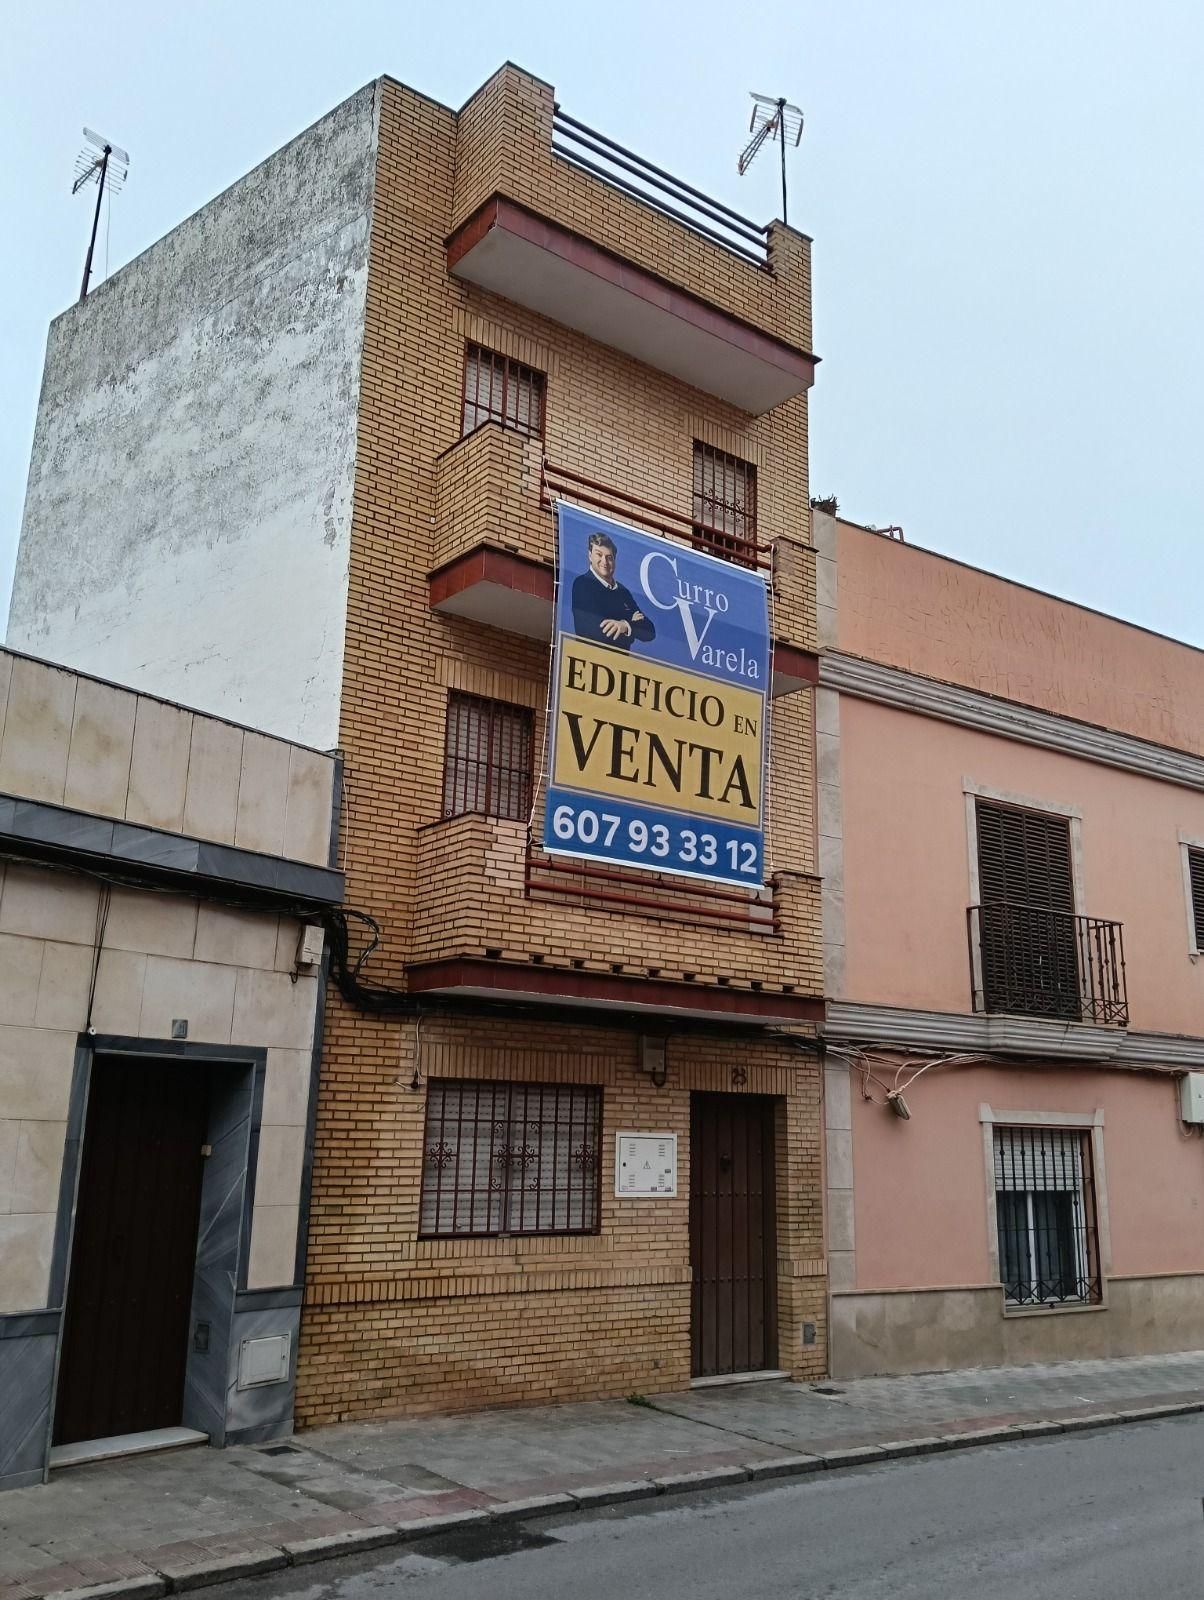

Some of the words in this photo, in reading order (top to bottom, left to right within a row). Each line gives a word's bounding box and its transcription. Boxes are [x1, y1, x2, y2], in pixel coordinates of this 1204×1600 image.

[639, 551, 729, 612] Curro
[673, 597, 760, 680] Varela
[566, 655, 725, 728] EDIFICIO
[733, 714, 757, 737] EN
[561, 710, 757, 809] VENTA
[553, 805, 621, 847] 607
[628, 819, 670, 857] 93
[678, 829, 718, 866] 33
[726, 839, 757, 874] 12
